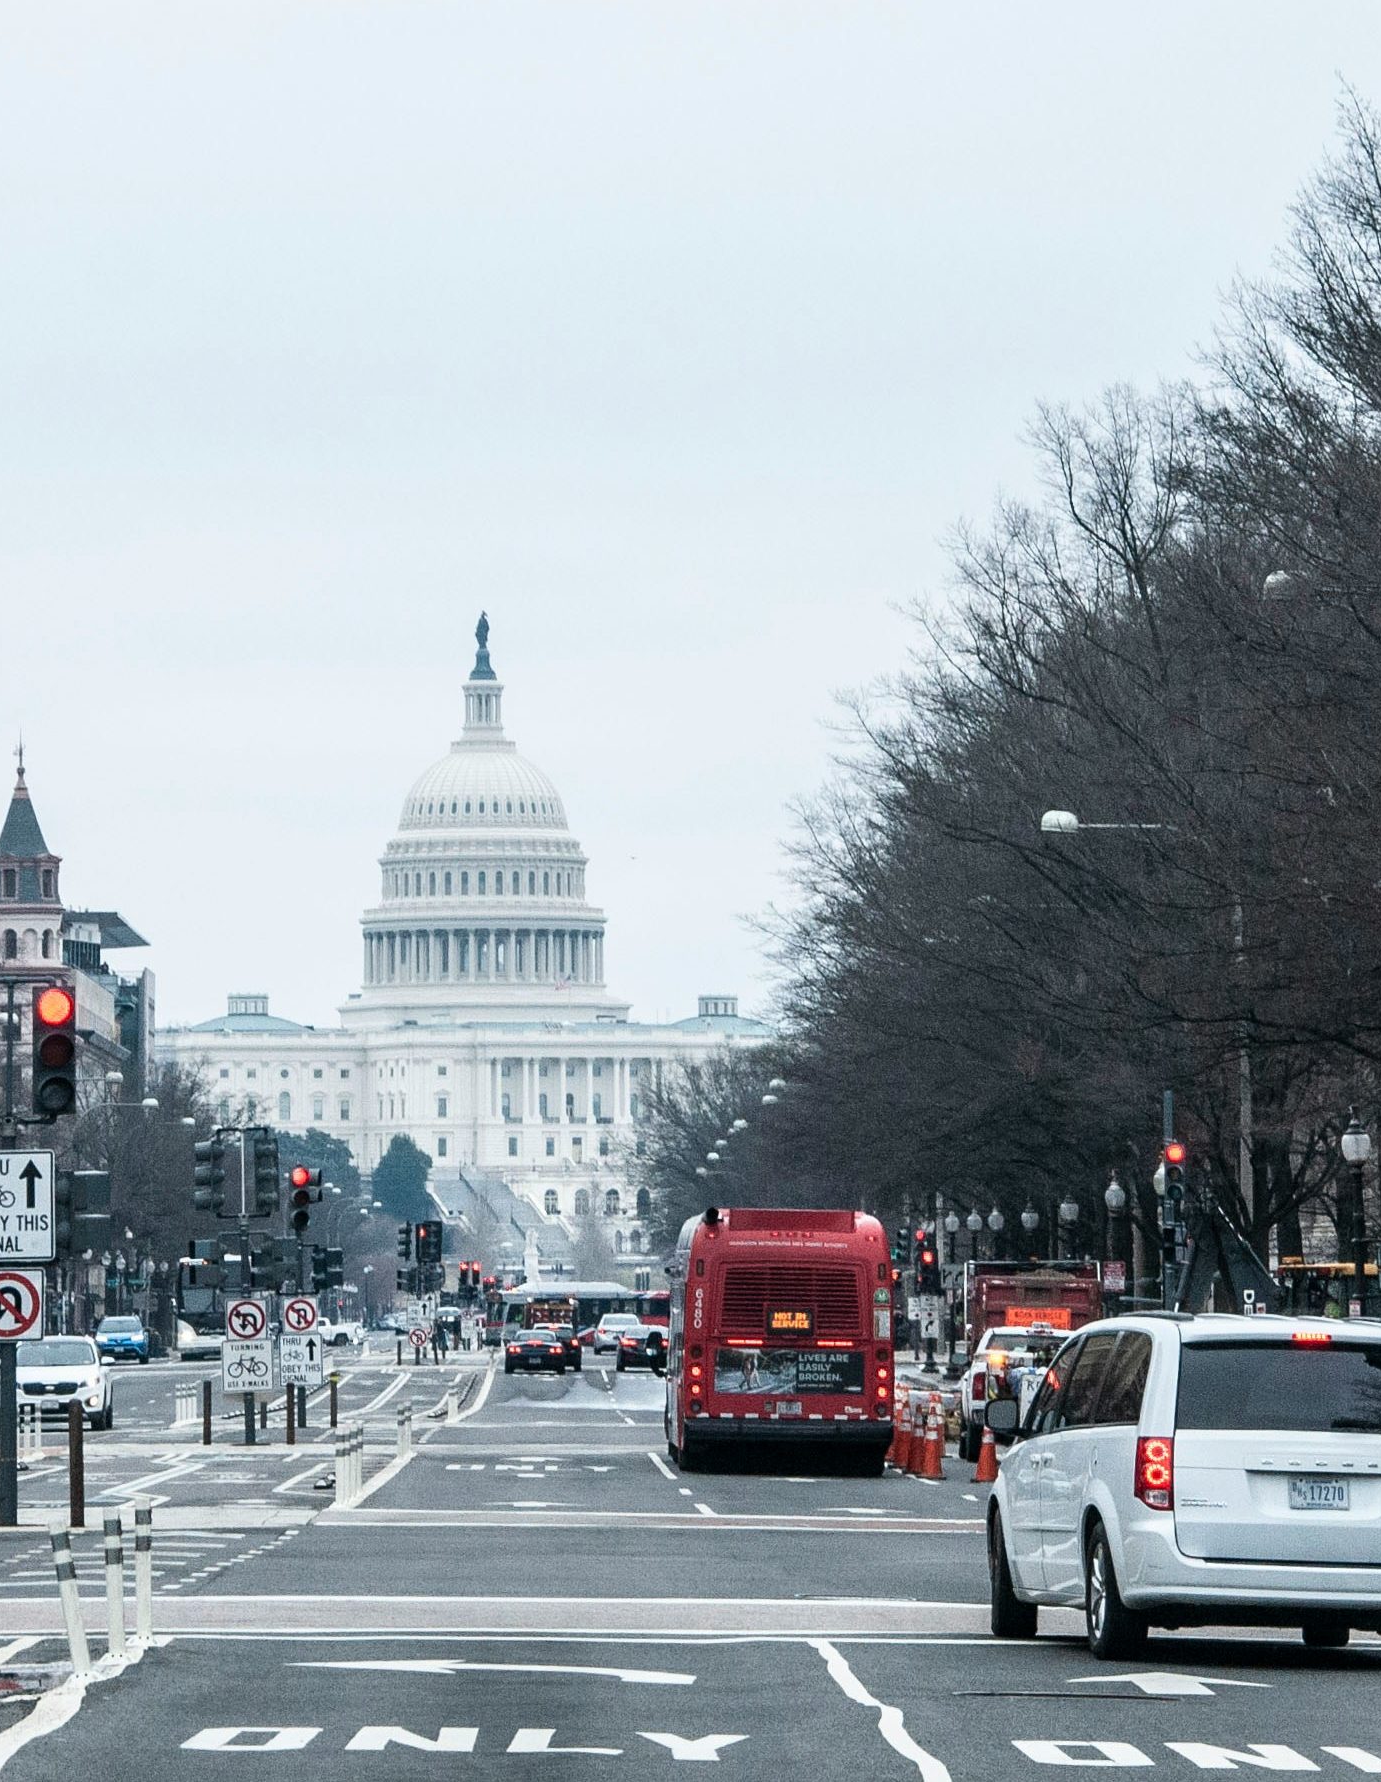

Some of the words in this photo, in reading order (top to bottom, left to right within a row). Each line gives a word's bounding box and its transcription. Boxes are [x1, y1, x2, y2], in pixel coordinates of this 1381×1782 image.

[16, 1214, 49, 1231] THIS
[694, 1288, 704, 1329] 6480
[774, 1312, 792, 1320] NOT
[795, 1312, 806, 1320] IN
[772, 1320, 809, 1329] SERVICE
[282, 1337, 301, 1346] THRU
[231, 1343, 265, 1351] TURNING
[798, 1353, 827, 1362] LIVES
[829, 1354, 849, 1363] ARE
[282, 1365, 301, 1373] OBEY
[305, 1364, 321, 1372] THIS
[798, 1363, 831, 1372] EASILY
[282, 1375, 308, 1384] SIGNAL
[798, 1373, 842, 1382] BROKEN.
[445, 1464, 618, 1472] ONLY
[1310, 1485, 1344, 1501] 17270
[180, 1725, 751, 1761] ONLY
